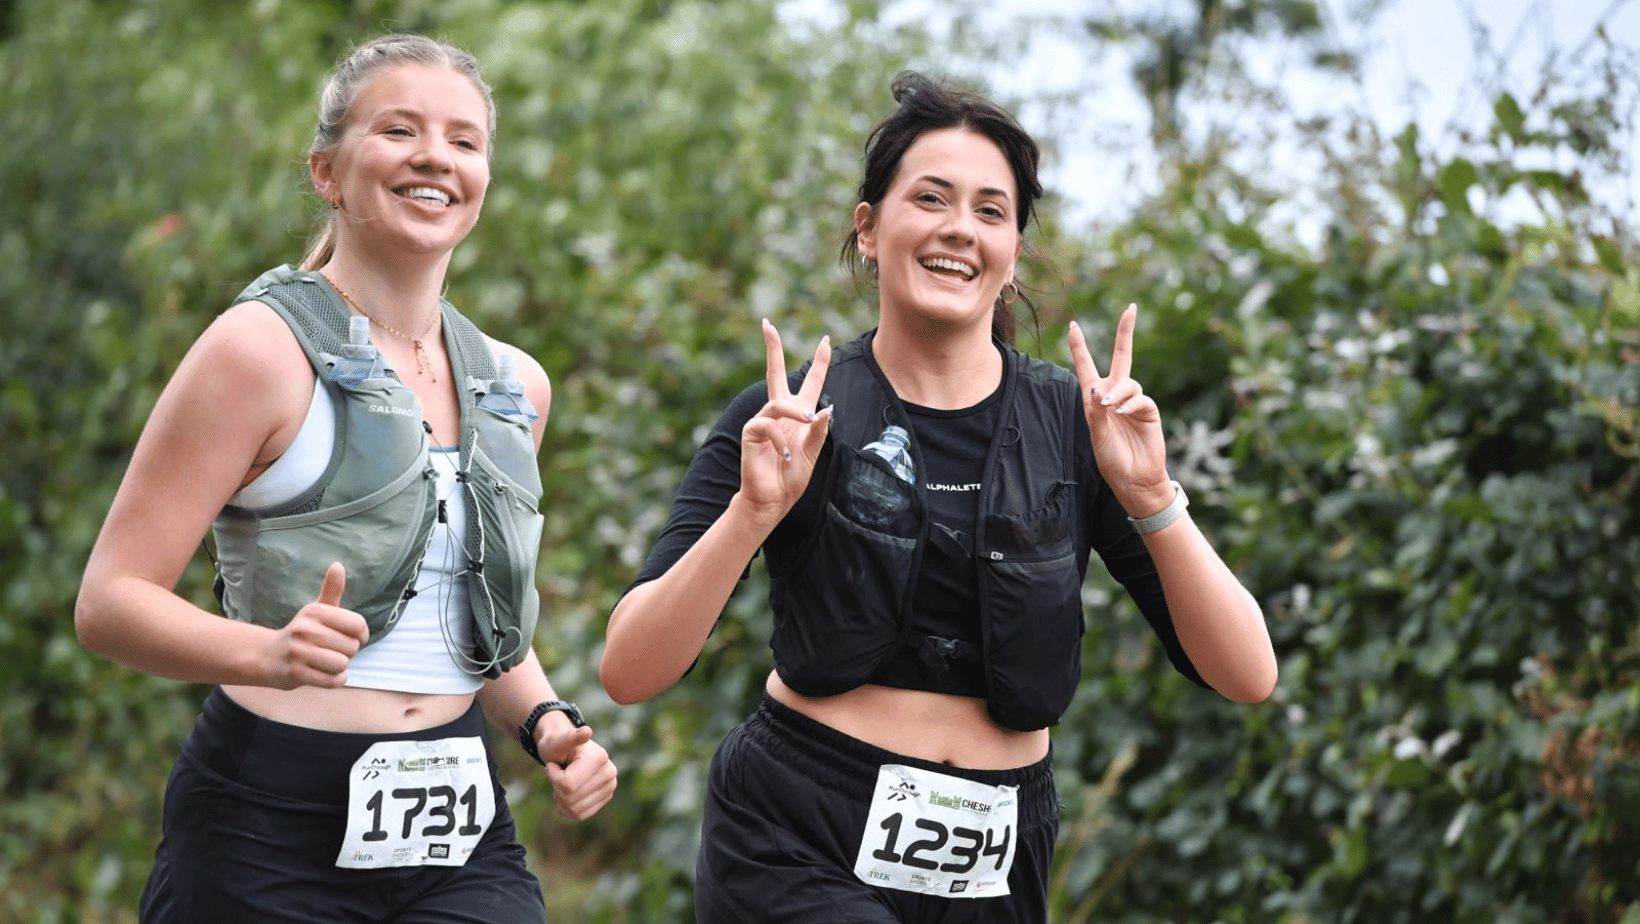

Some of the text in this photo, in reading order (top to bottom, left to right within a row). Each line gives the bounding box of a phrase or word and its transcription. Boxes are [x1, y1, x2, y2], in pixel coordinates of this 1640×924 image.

[362, 784, 482, 842] 1731
[872, 812, 1011, 874] 1234
[869, 870, 890, 881] TREK
